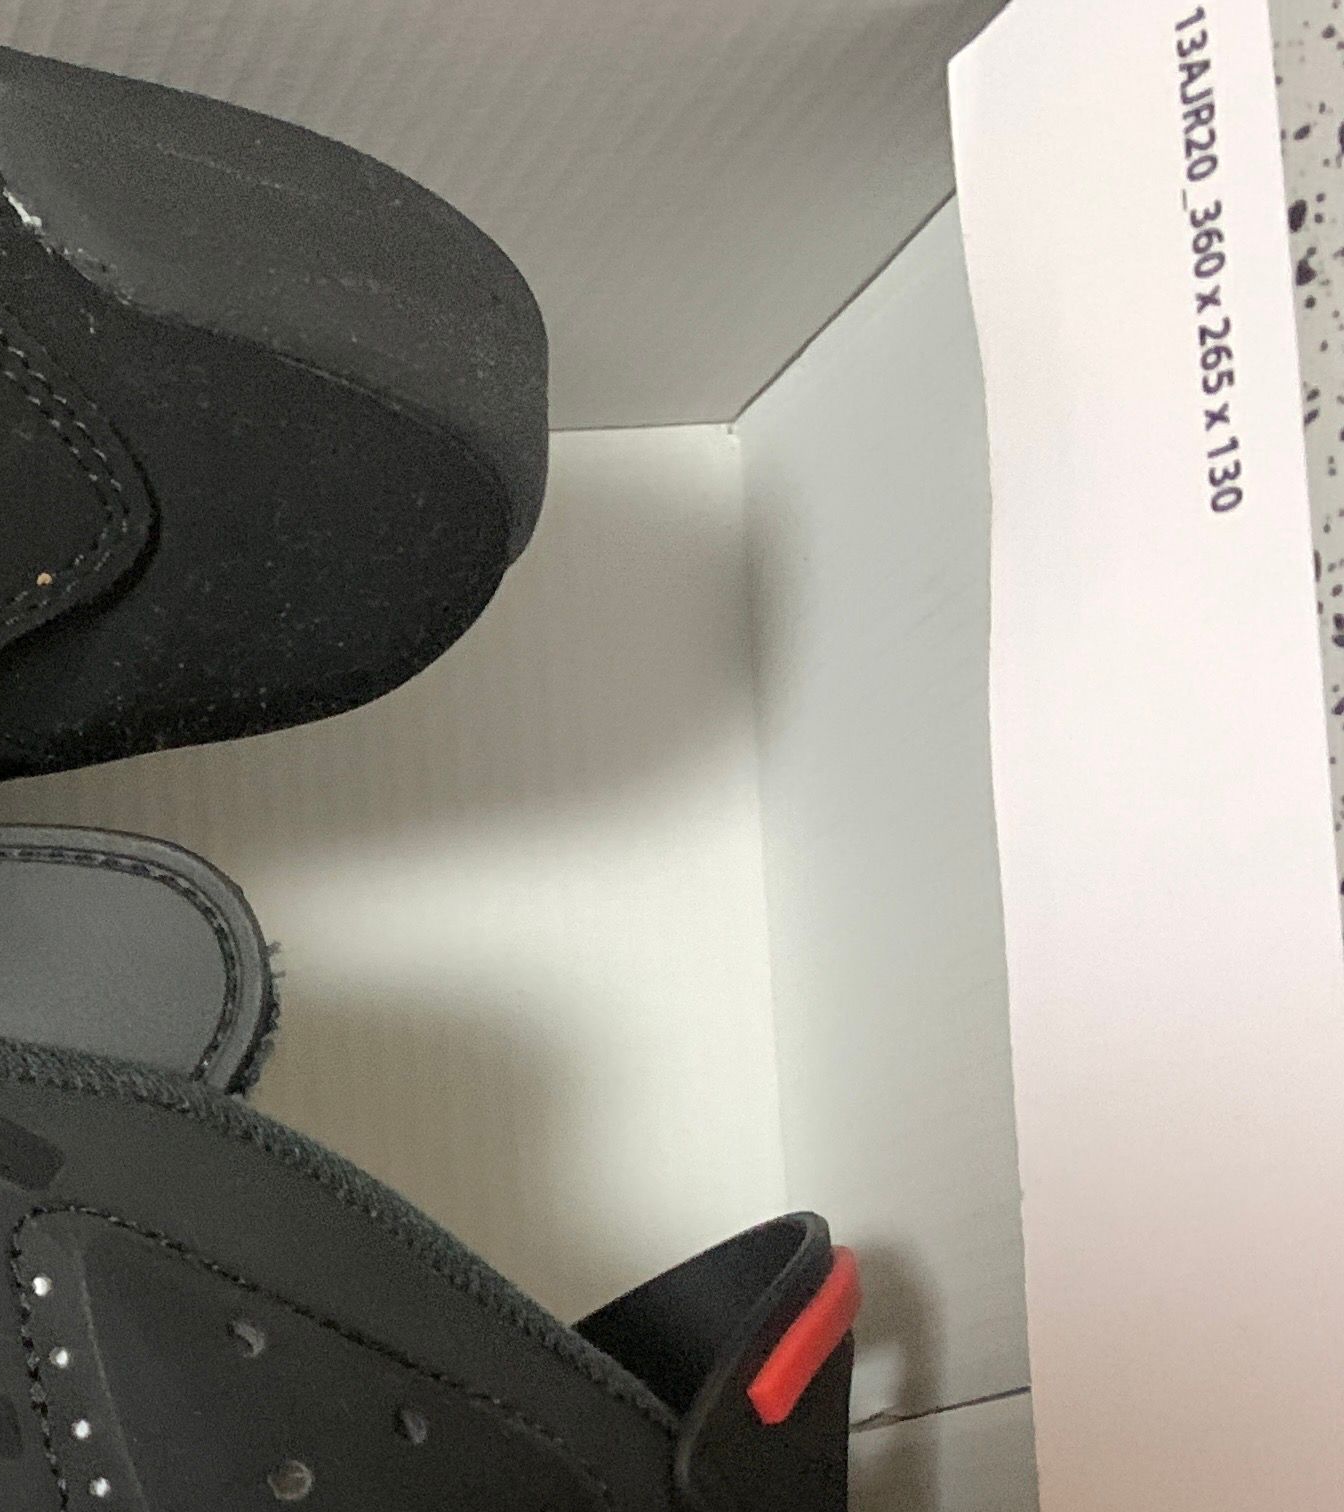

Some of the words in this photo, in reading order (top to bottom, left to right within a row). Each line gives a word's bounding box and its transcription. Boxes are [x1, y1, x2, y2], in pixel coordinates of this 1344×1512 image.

[1195, 284, 1222, 314] x
[1198, 316, 1235, 395] 265
[1204, 402, 1231, 432] x
[1207, 436, 1244, 513] 130
